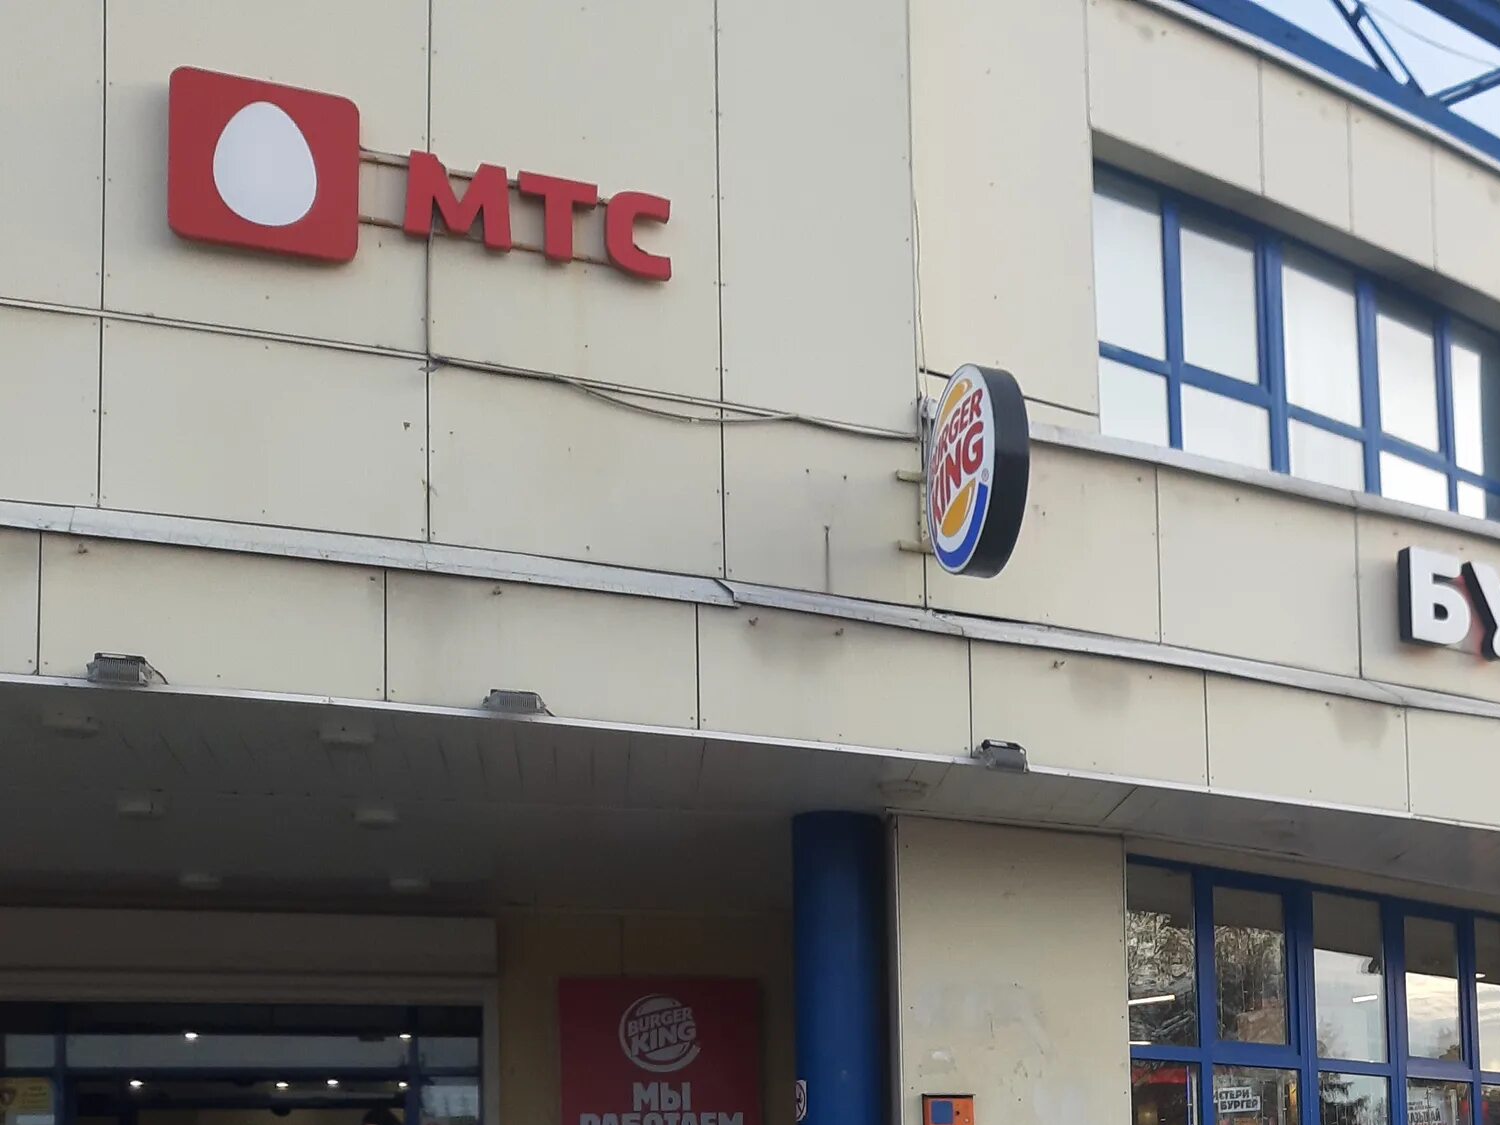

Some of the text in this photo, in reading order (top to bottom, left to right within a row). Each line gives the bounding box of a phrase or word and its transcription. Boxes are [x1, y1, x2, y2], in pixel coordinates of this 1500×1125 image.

[402, 150, 672, 282] МТС
[931, 387, 984, 477] BURGER
[931, 420, 985, 528] KING
[628, 1006, 693, 1037] BURGER
[631, 1021, 697, 1057] KING
[632, 1082, 692, 1112] МЫ
[1220, 1099, 1259, 1111] БУРГЕР
